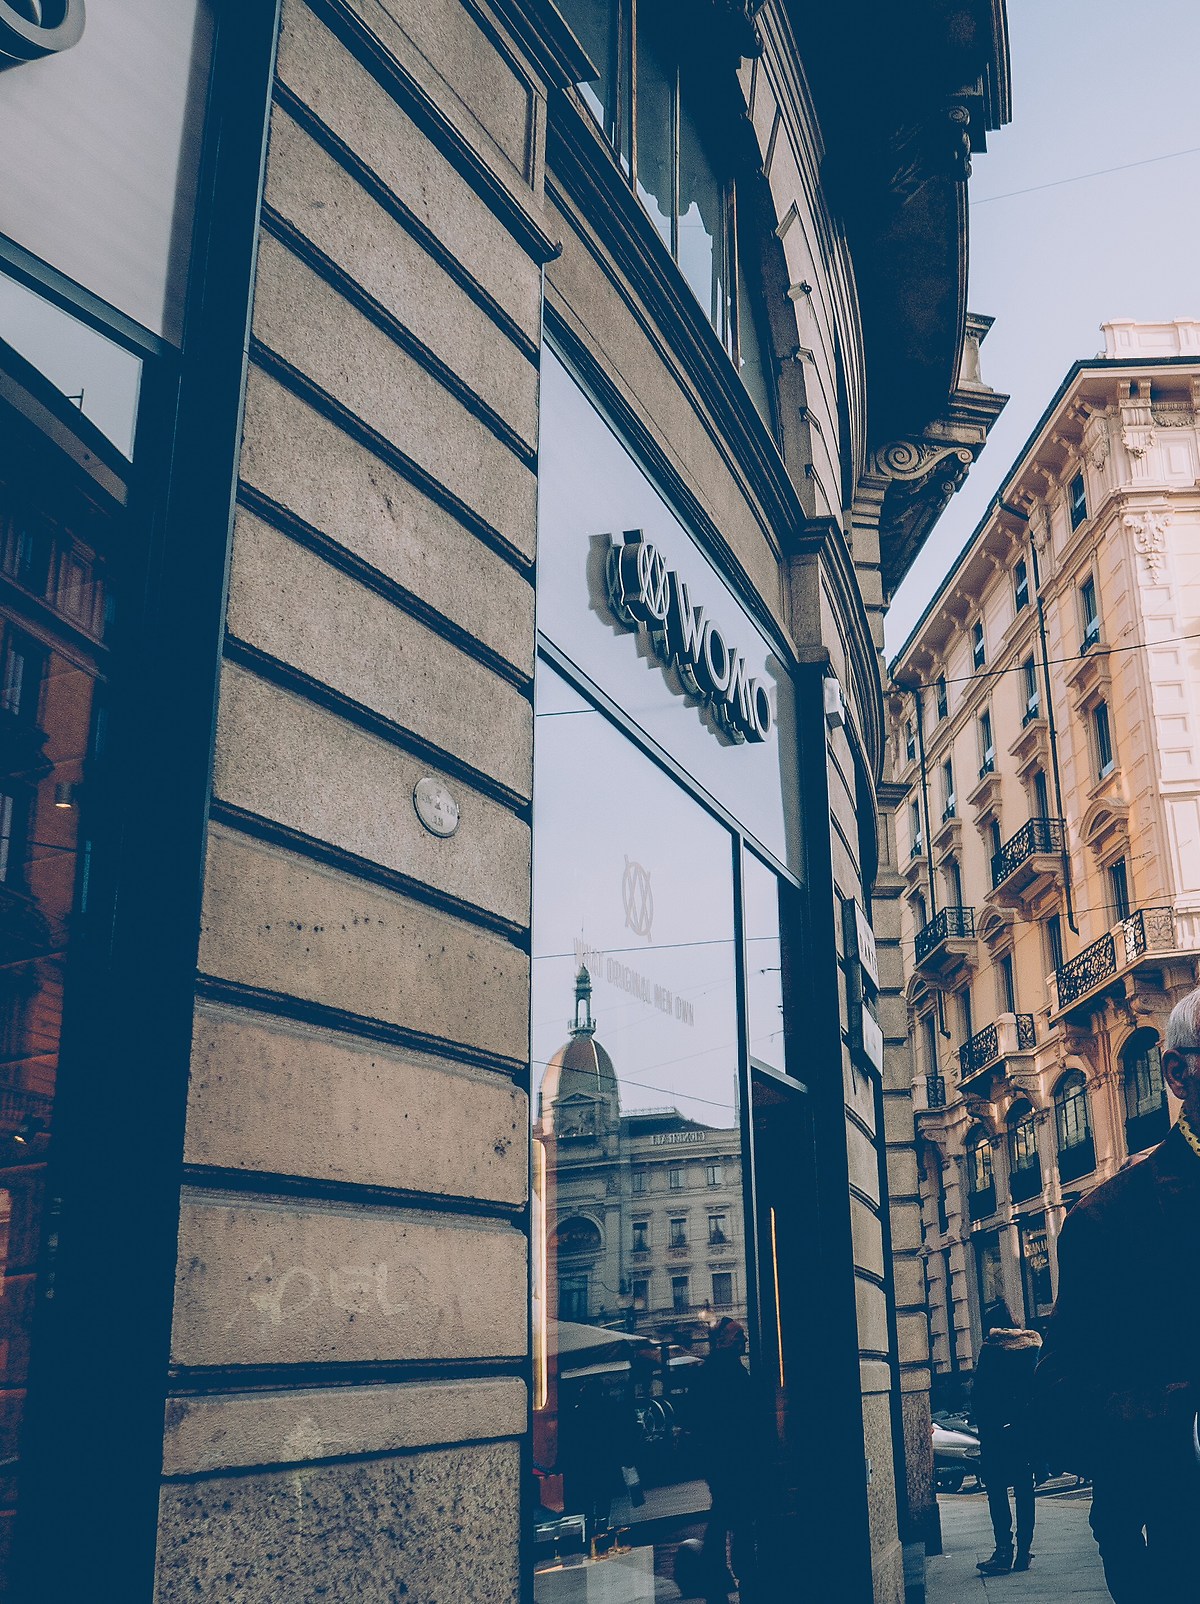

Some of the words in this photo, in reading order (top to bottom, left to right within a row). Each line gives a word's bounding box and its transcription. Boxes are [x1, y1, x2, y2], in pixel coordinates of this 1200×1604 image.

[667, 570, 772, 743] WOMO
[607, 957, 651, 1004] ORIGINAL
[653, 983, 673, 1015] MEN
[675, 996, 694, 1027] OWN
